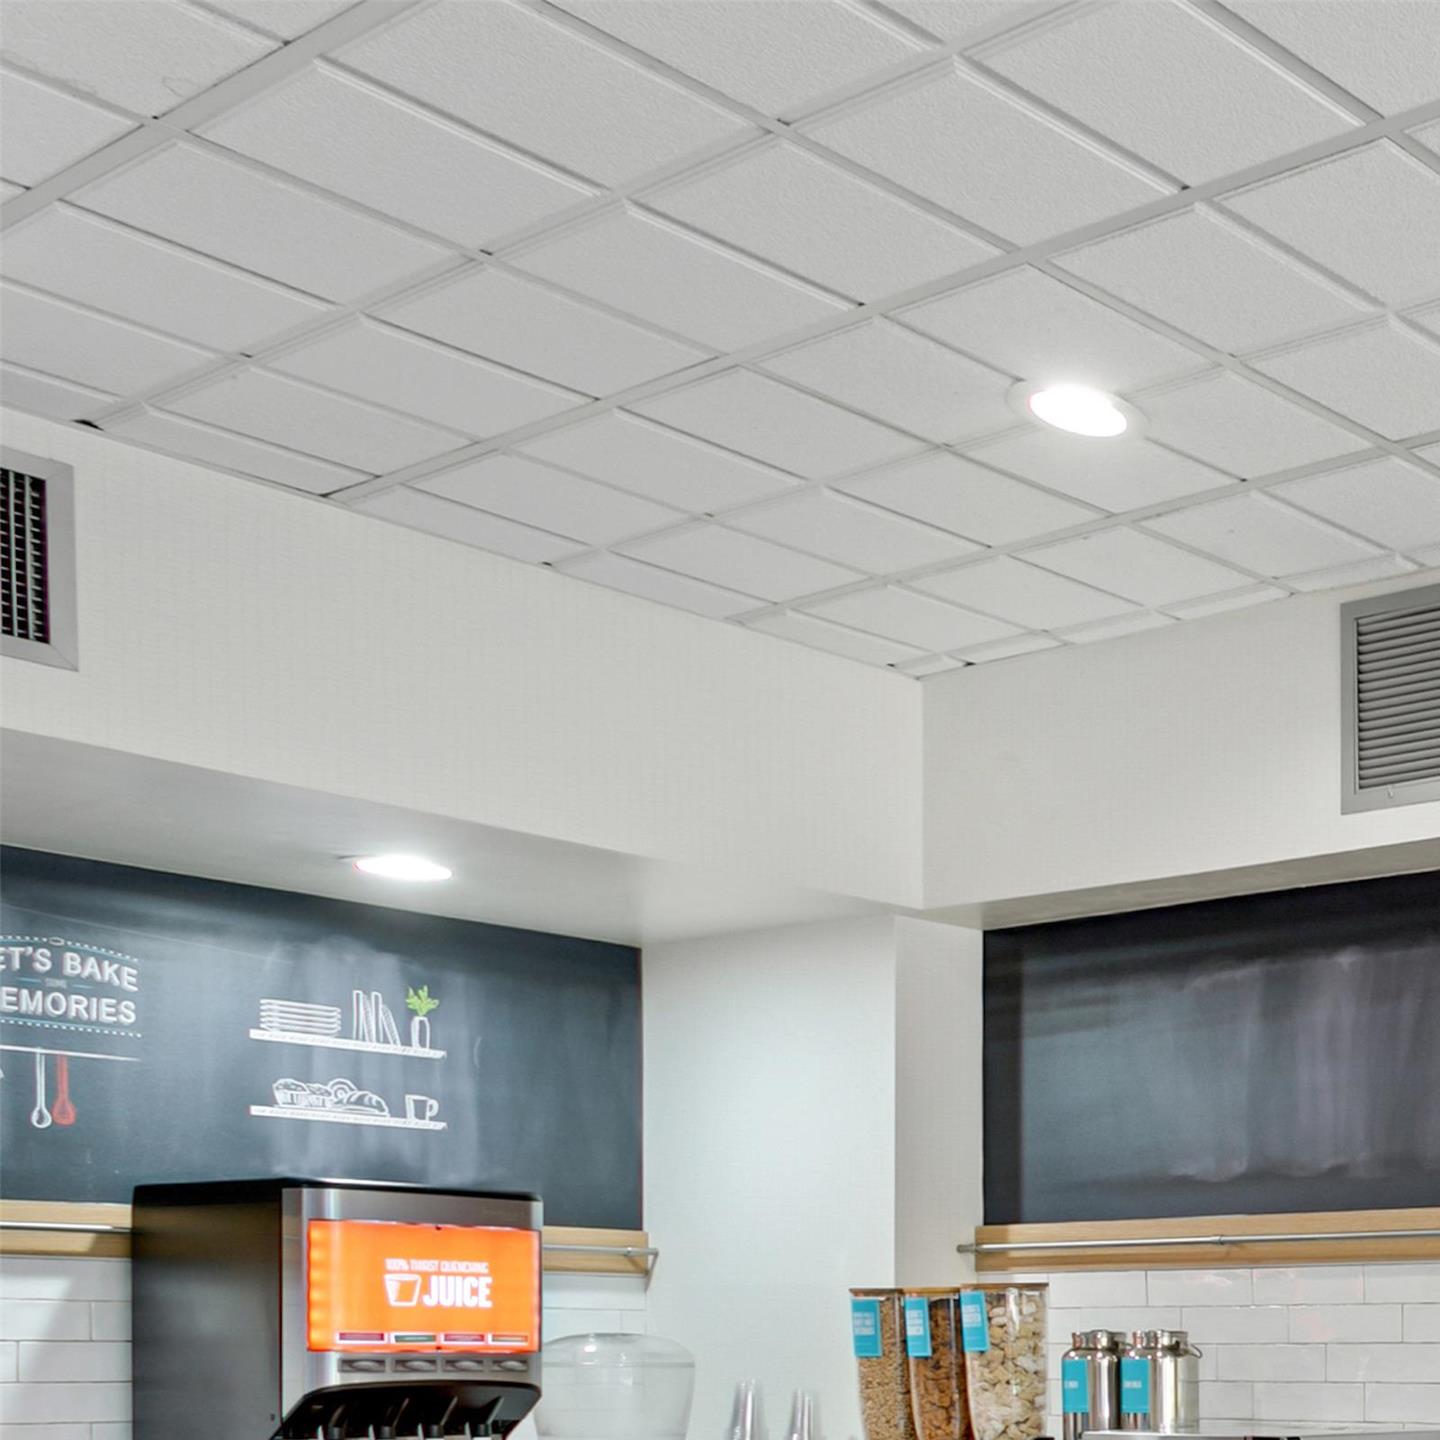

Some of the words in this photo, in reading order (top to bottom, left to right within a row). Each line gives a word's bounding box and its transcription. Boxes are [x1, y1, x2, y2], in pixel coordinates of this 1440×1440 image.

[62, 951, 139, 992] BAKE
[0, 986, 137, 1025] EMORIES
[422, 1275, 493, 1308] JUICE
